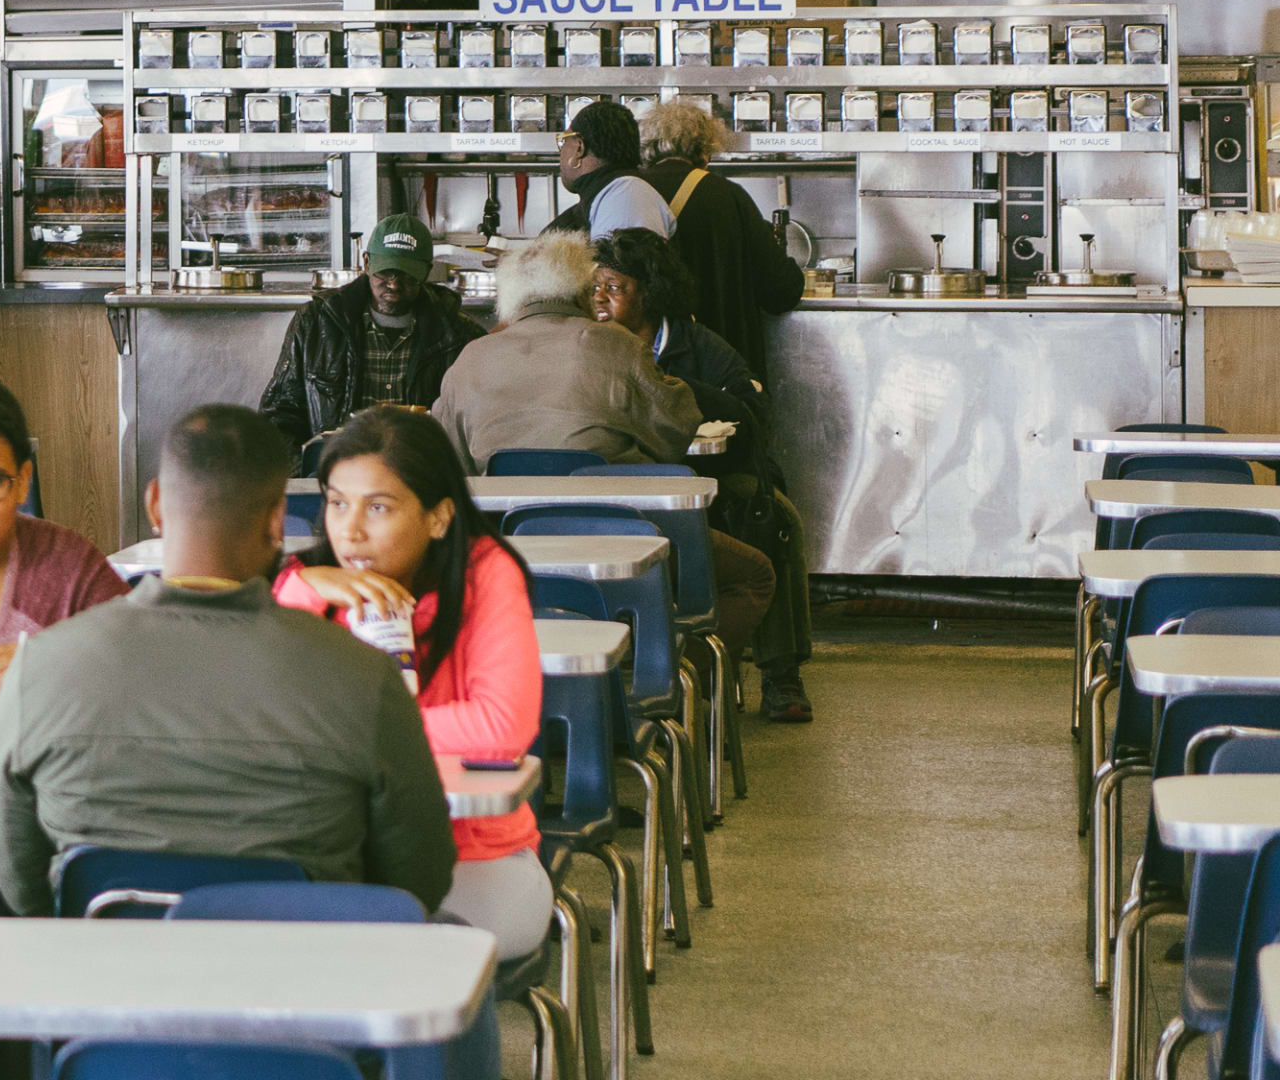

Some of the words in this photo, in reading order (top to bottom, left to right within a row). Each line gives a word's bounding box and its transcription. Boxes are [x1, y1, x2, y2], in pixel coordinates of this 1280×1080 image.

[756, 138, 785, 146] TARTAR
[790, 138, 818, 146] SAUCE
[910, 138, 948, 146] COCKTAIL
[953, 138, 979, 146] SAUCE
